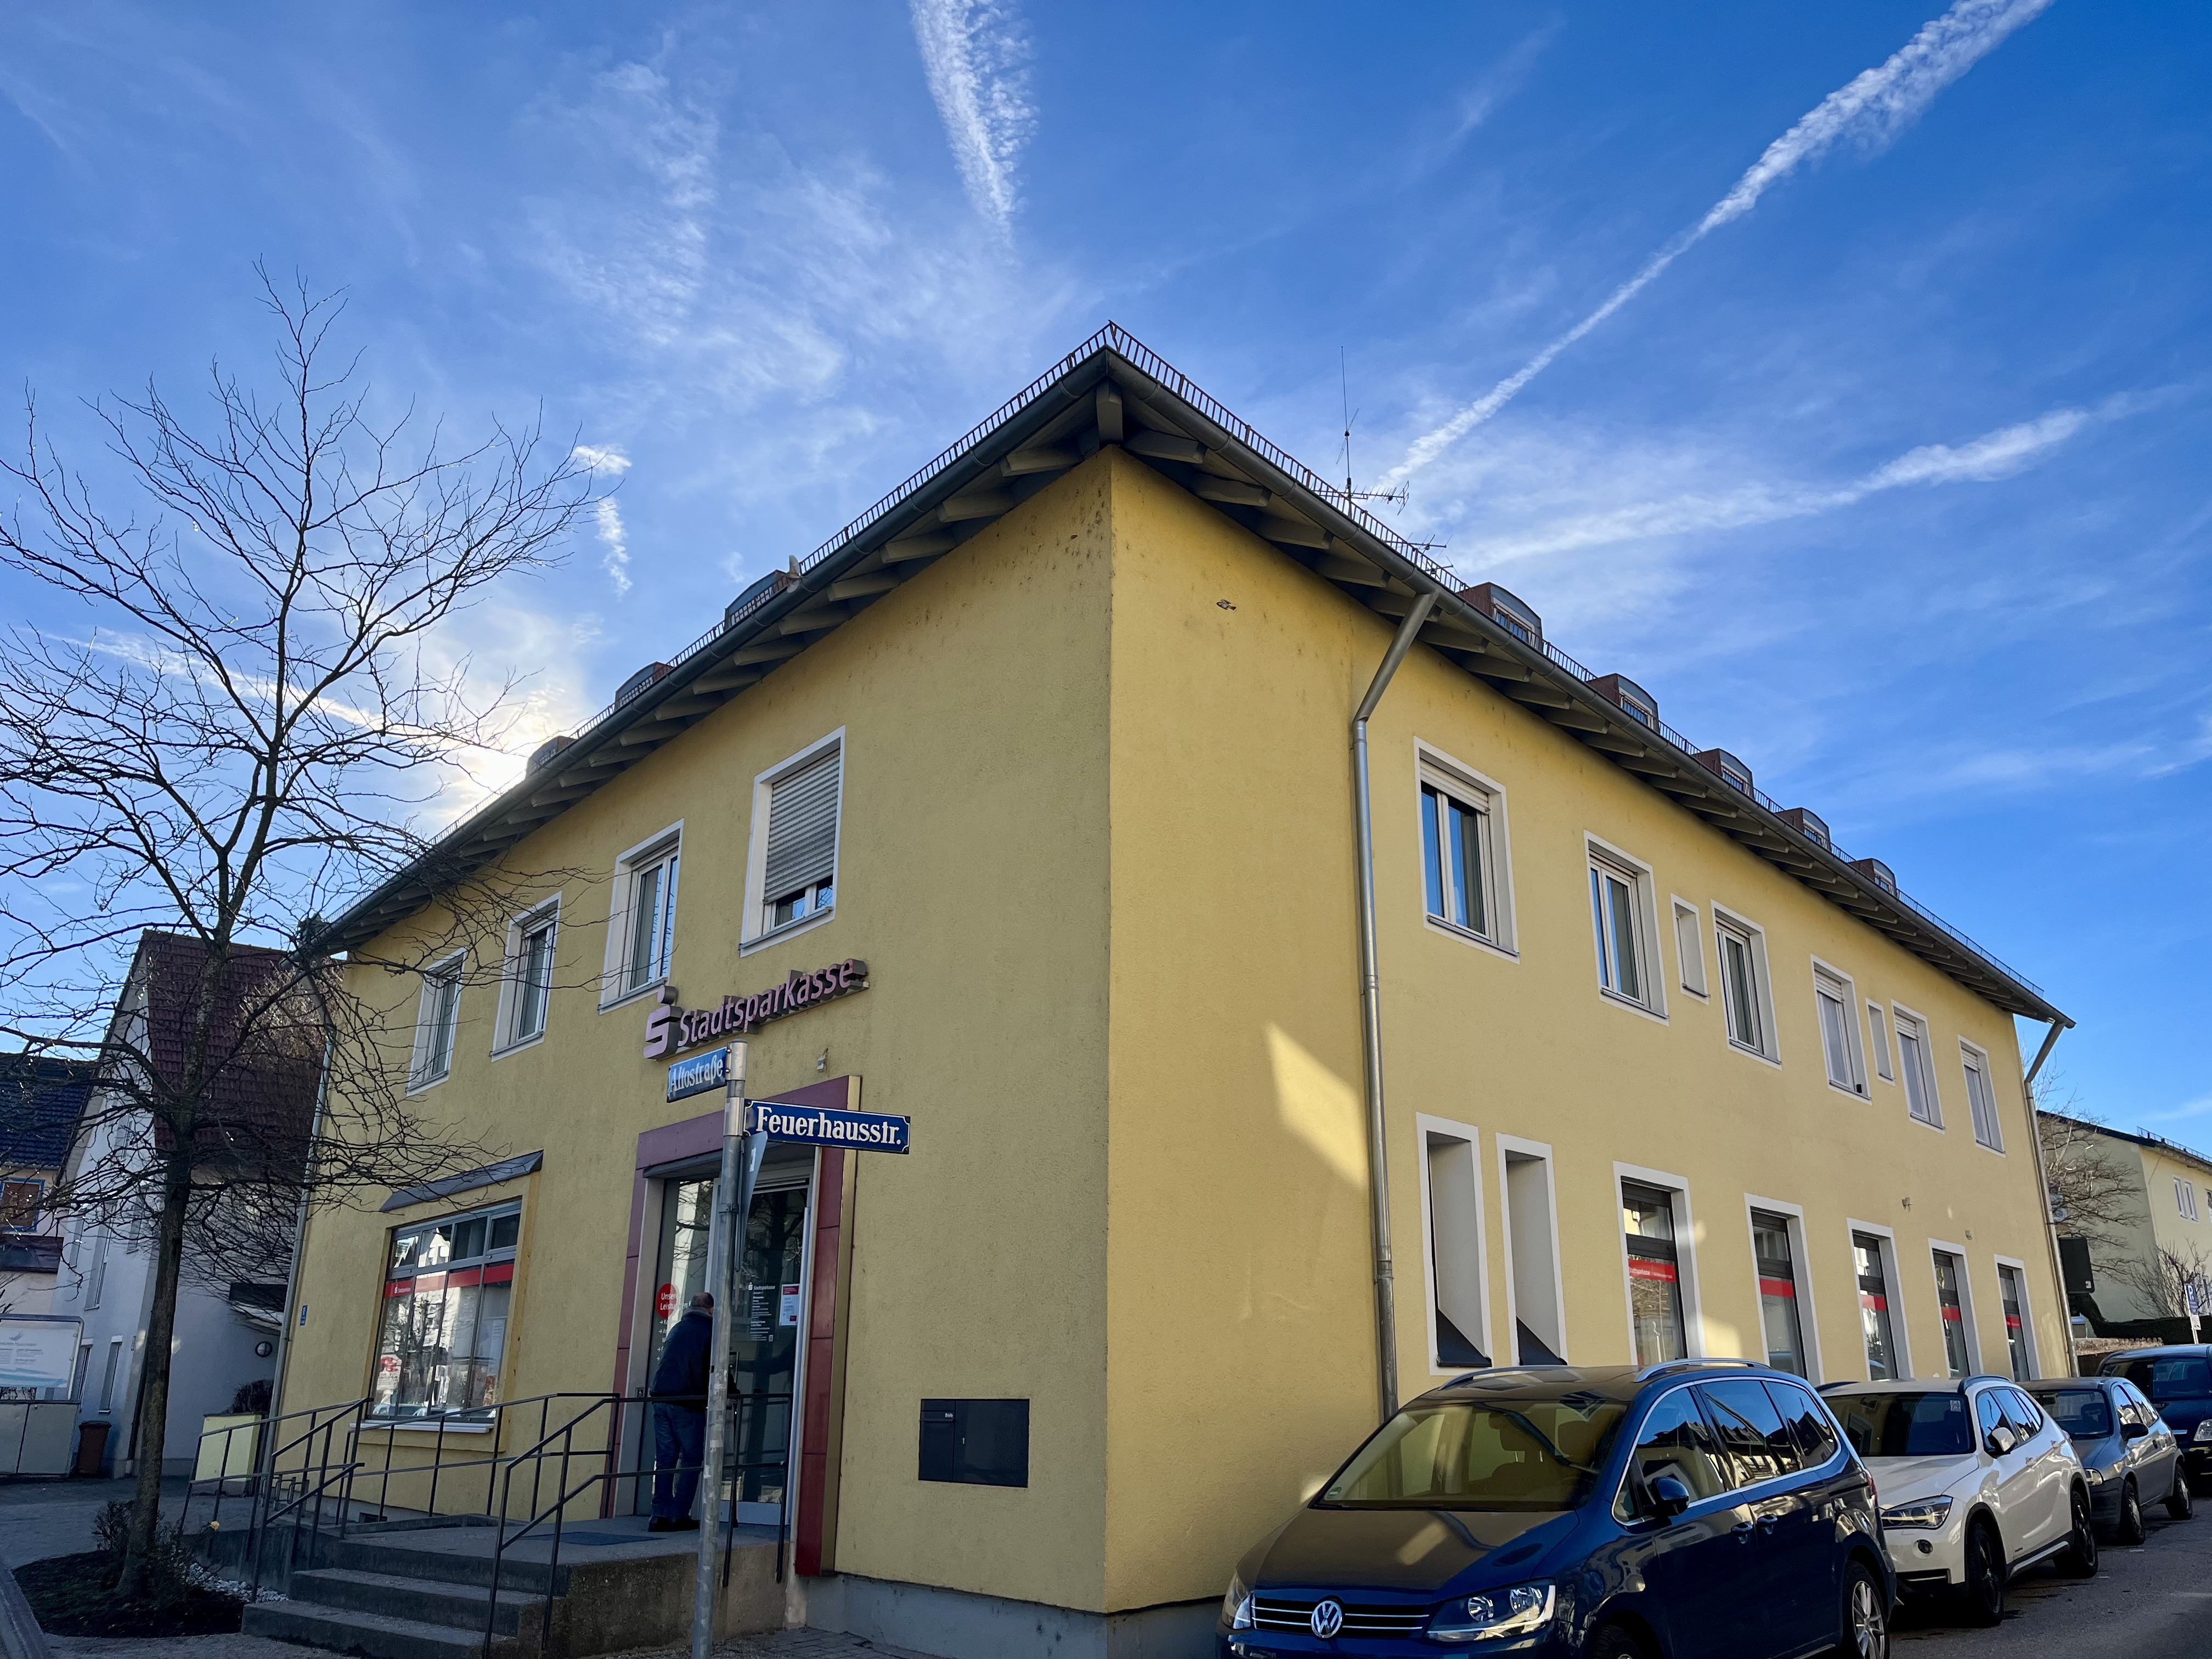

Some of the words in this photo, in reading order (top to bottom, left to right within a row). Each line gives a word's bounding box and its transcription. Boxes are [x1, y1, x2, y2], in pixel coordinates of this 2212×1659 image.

[678, 958, 856, 1047] Stadtsparkasse
[670, 1054, 724, 1092] Altostraße
[755, 1105, 901, 1145] Feuerhausstr.
